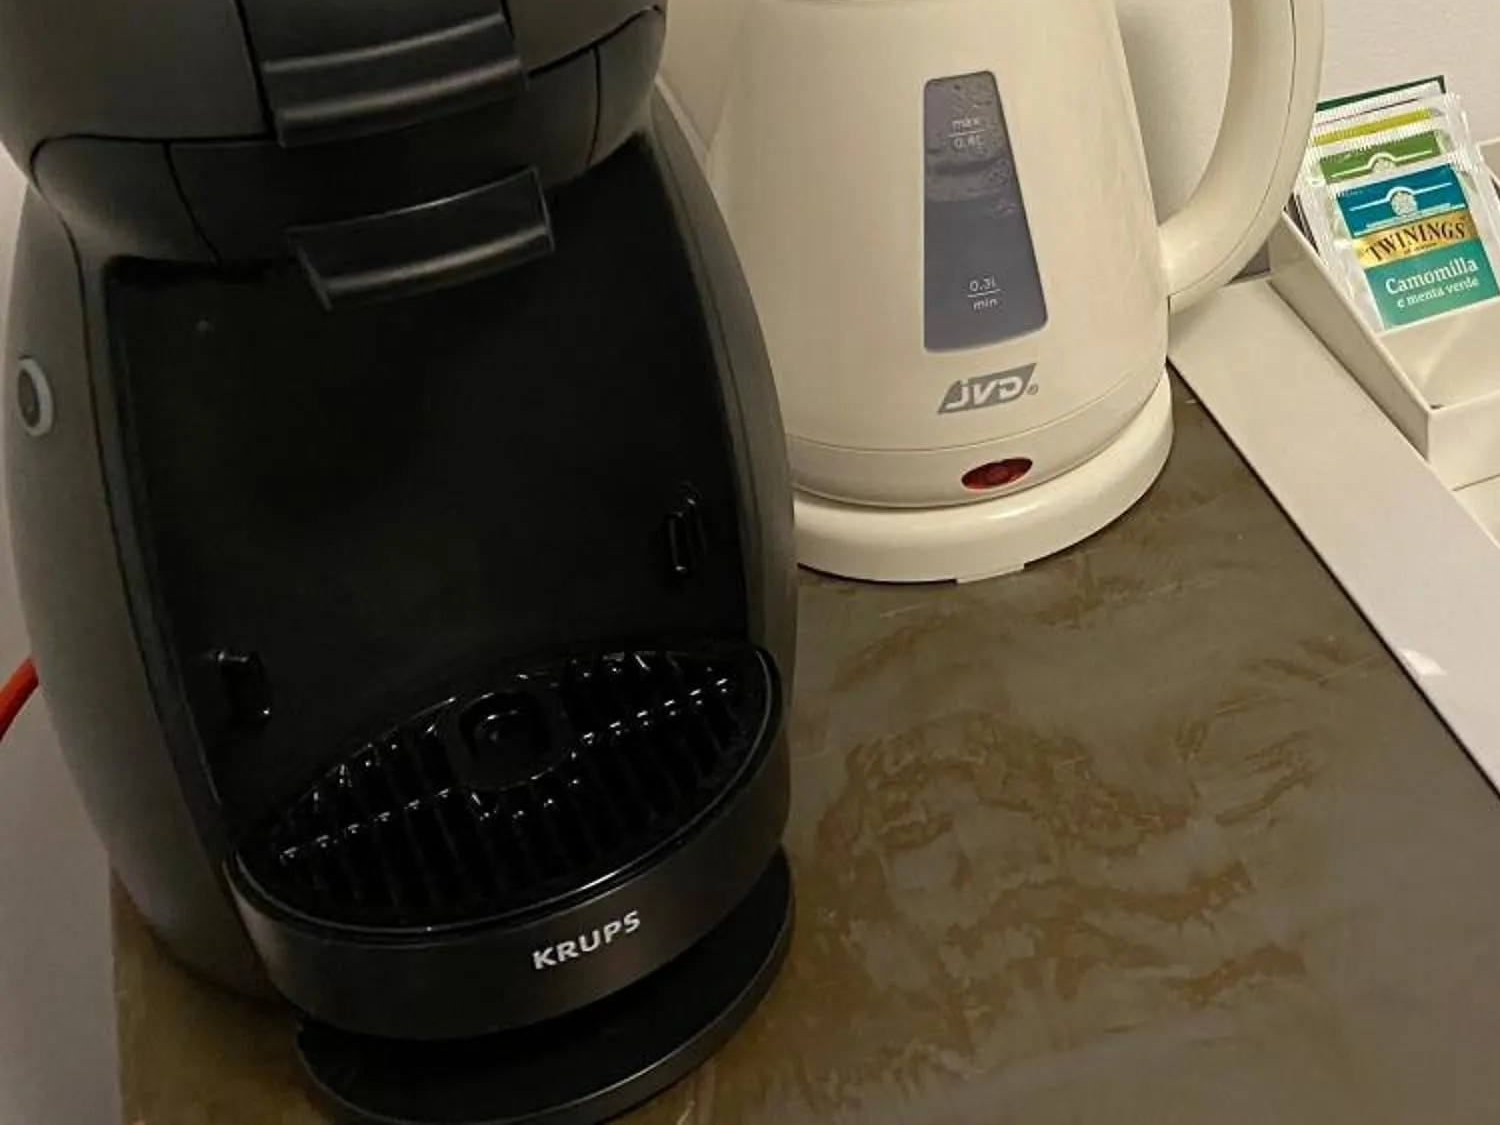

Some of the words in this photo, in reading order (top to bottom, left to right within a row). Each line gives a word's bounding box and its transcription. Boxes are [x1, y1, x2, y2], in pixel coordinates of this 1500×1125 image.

[1366, 221, 1466, 262] TWININGS
[1385, 257, 1480, 295] Camomilla
[1396, 297, 1406, 309] e
[1406, 287, 1445, 307] menta
[1445, 277, 1480, 295] verde
[973, 298, 998, 312] min
[532, 910, 641, 970] KRUPS
